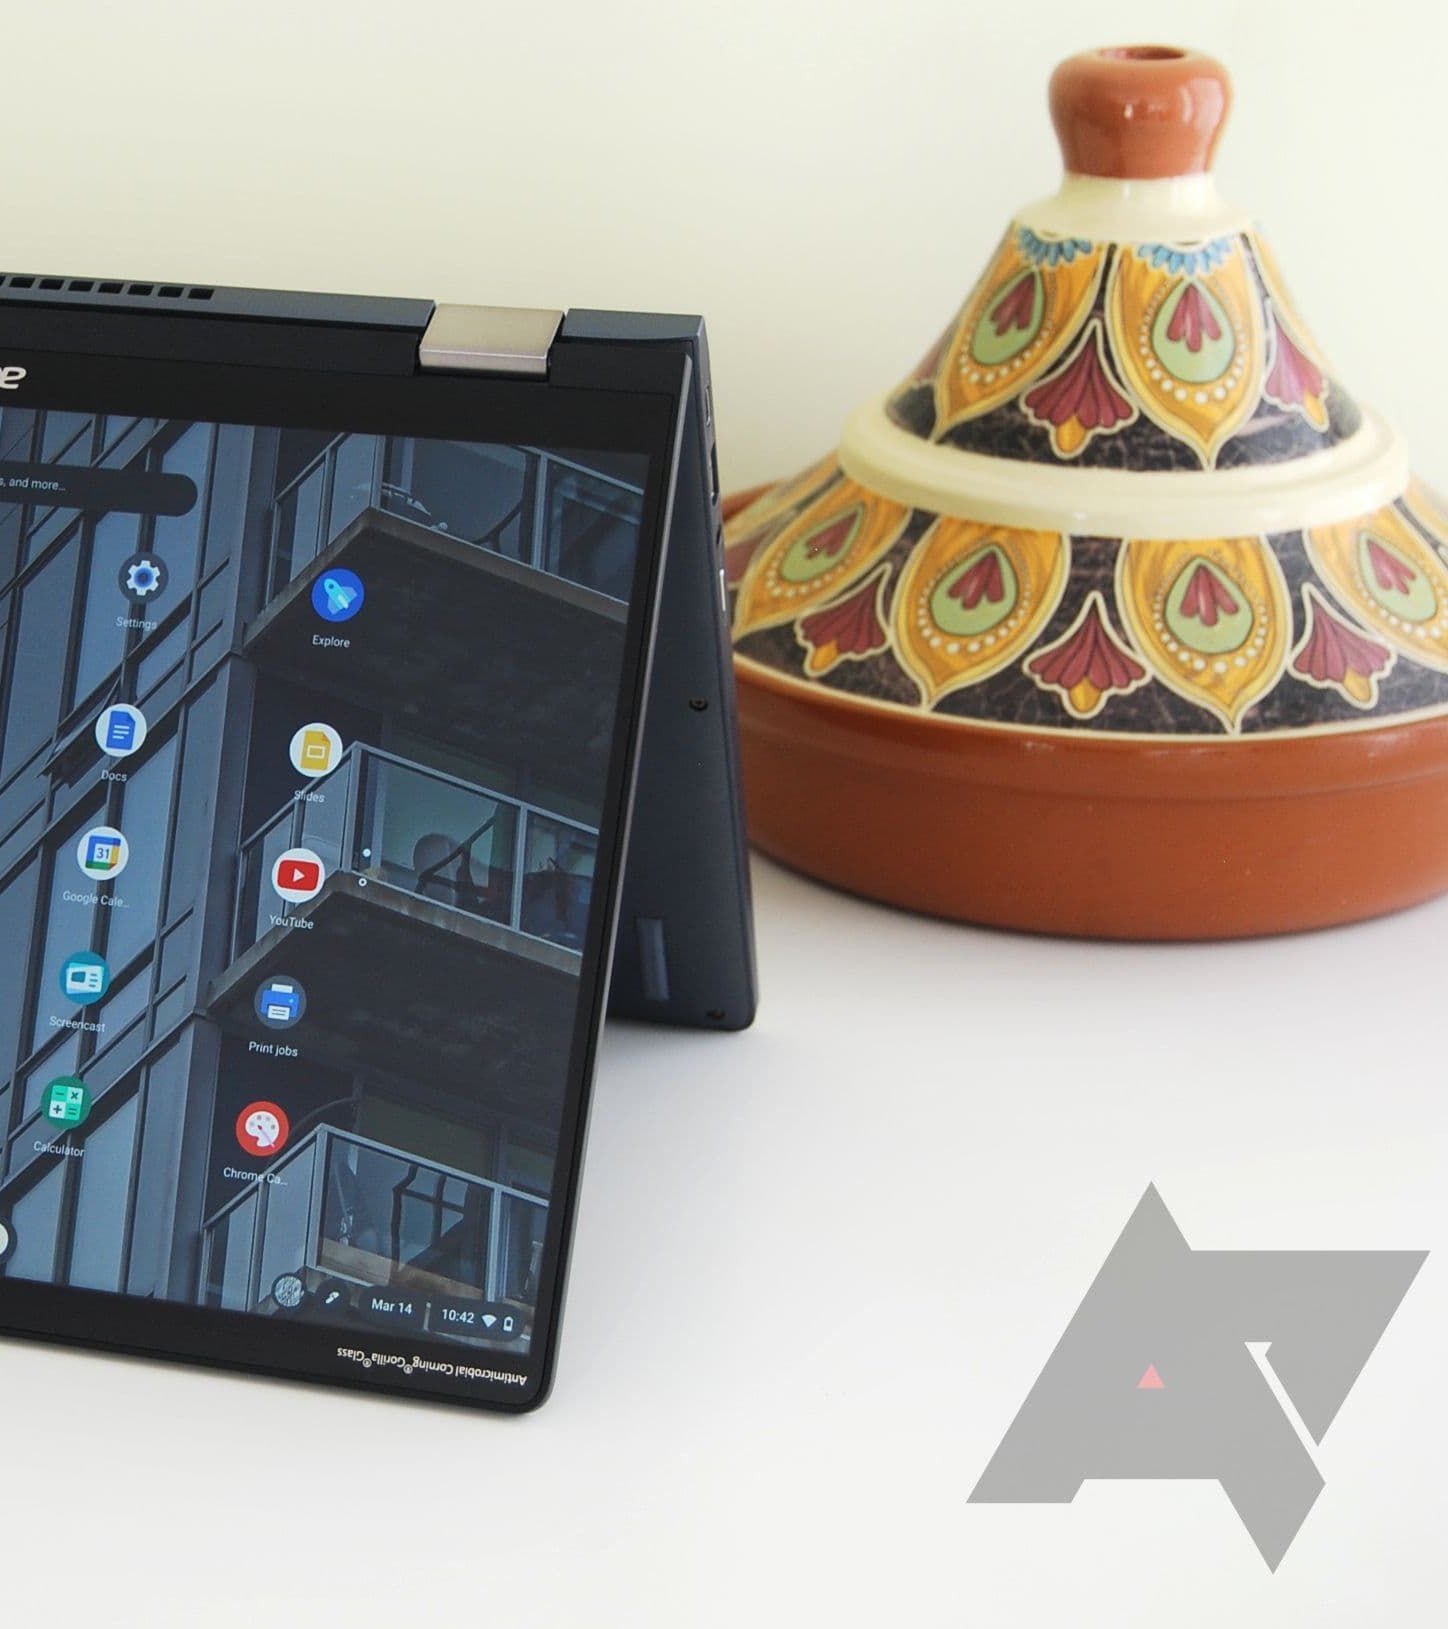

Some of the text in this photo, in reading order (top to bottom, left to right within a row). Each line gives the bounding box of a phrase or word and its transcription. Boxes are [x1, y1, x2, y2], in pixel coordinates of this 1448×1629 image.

[8, 477, 29, 489] and
[115, 615, 158, 632] Settings
[311, 634, 351, 650] Explore
[100, 768, 128, 783] Docs
[293, 788, 326, 804] Slides
[95, 847, 111, 859] 31
[63, 891, 98, 907] Google
[269, 914, 315, 930] YouTube
[49, 1015, 106, 1033] Screencast
[248, 1041, 299, 1059] Print jobs
[33, 1141, 84, 1157] Calculator
[222, 1166, 265, 1184] Chrome
[371, 1298, 413, 1315] Mar 14
[442, 1308, 475, 1324] 10:42
[337, 1347, 366, 1361] Glass
[455, 1365, 528, 1386] Antimicrobial
